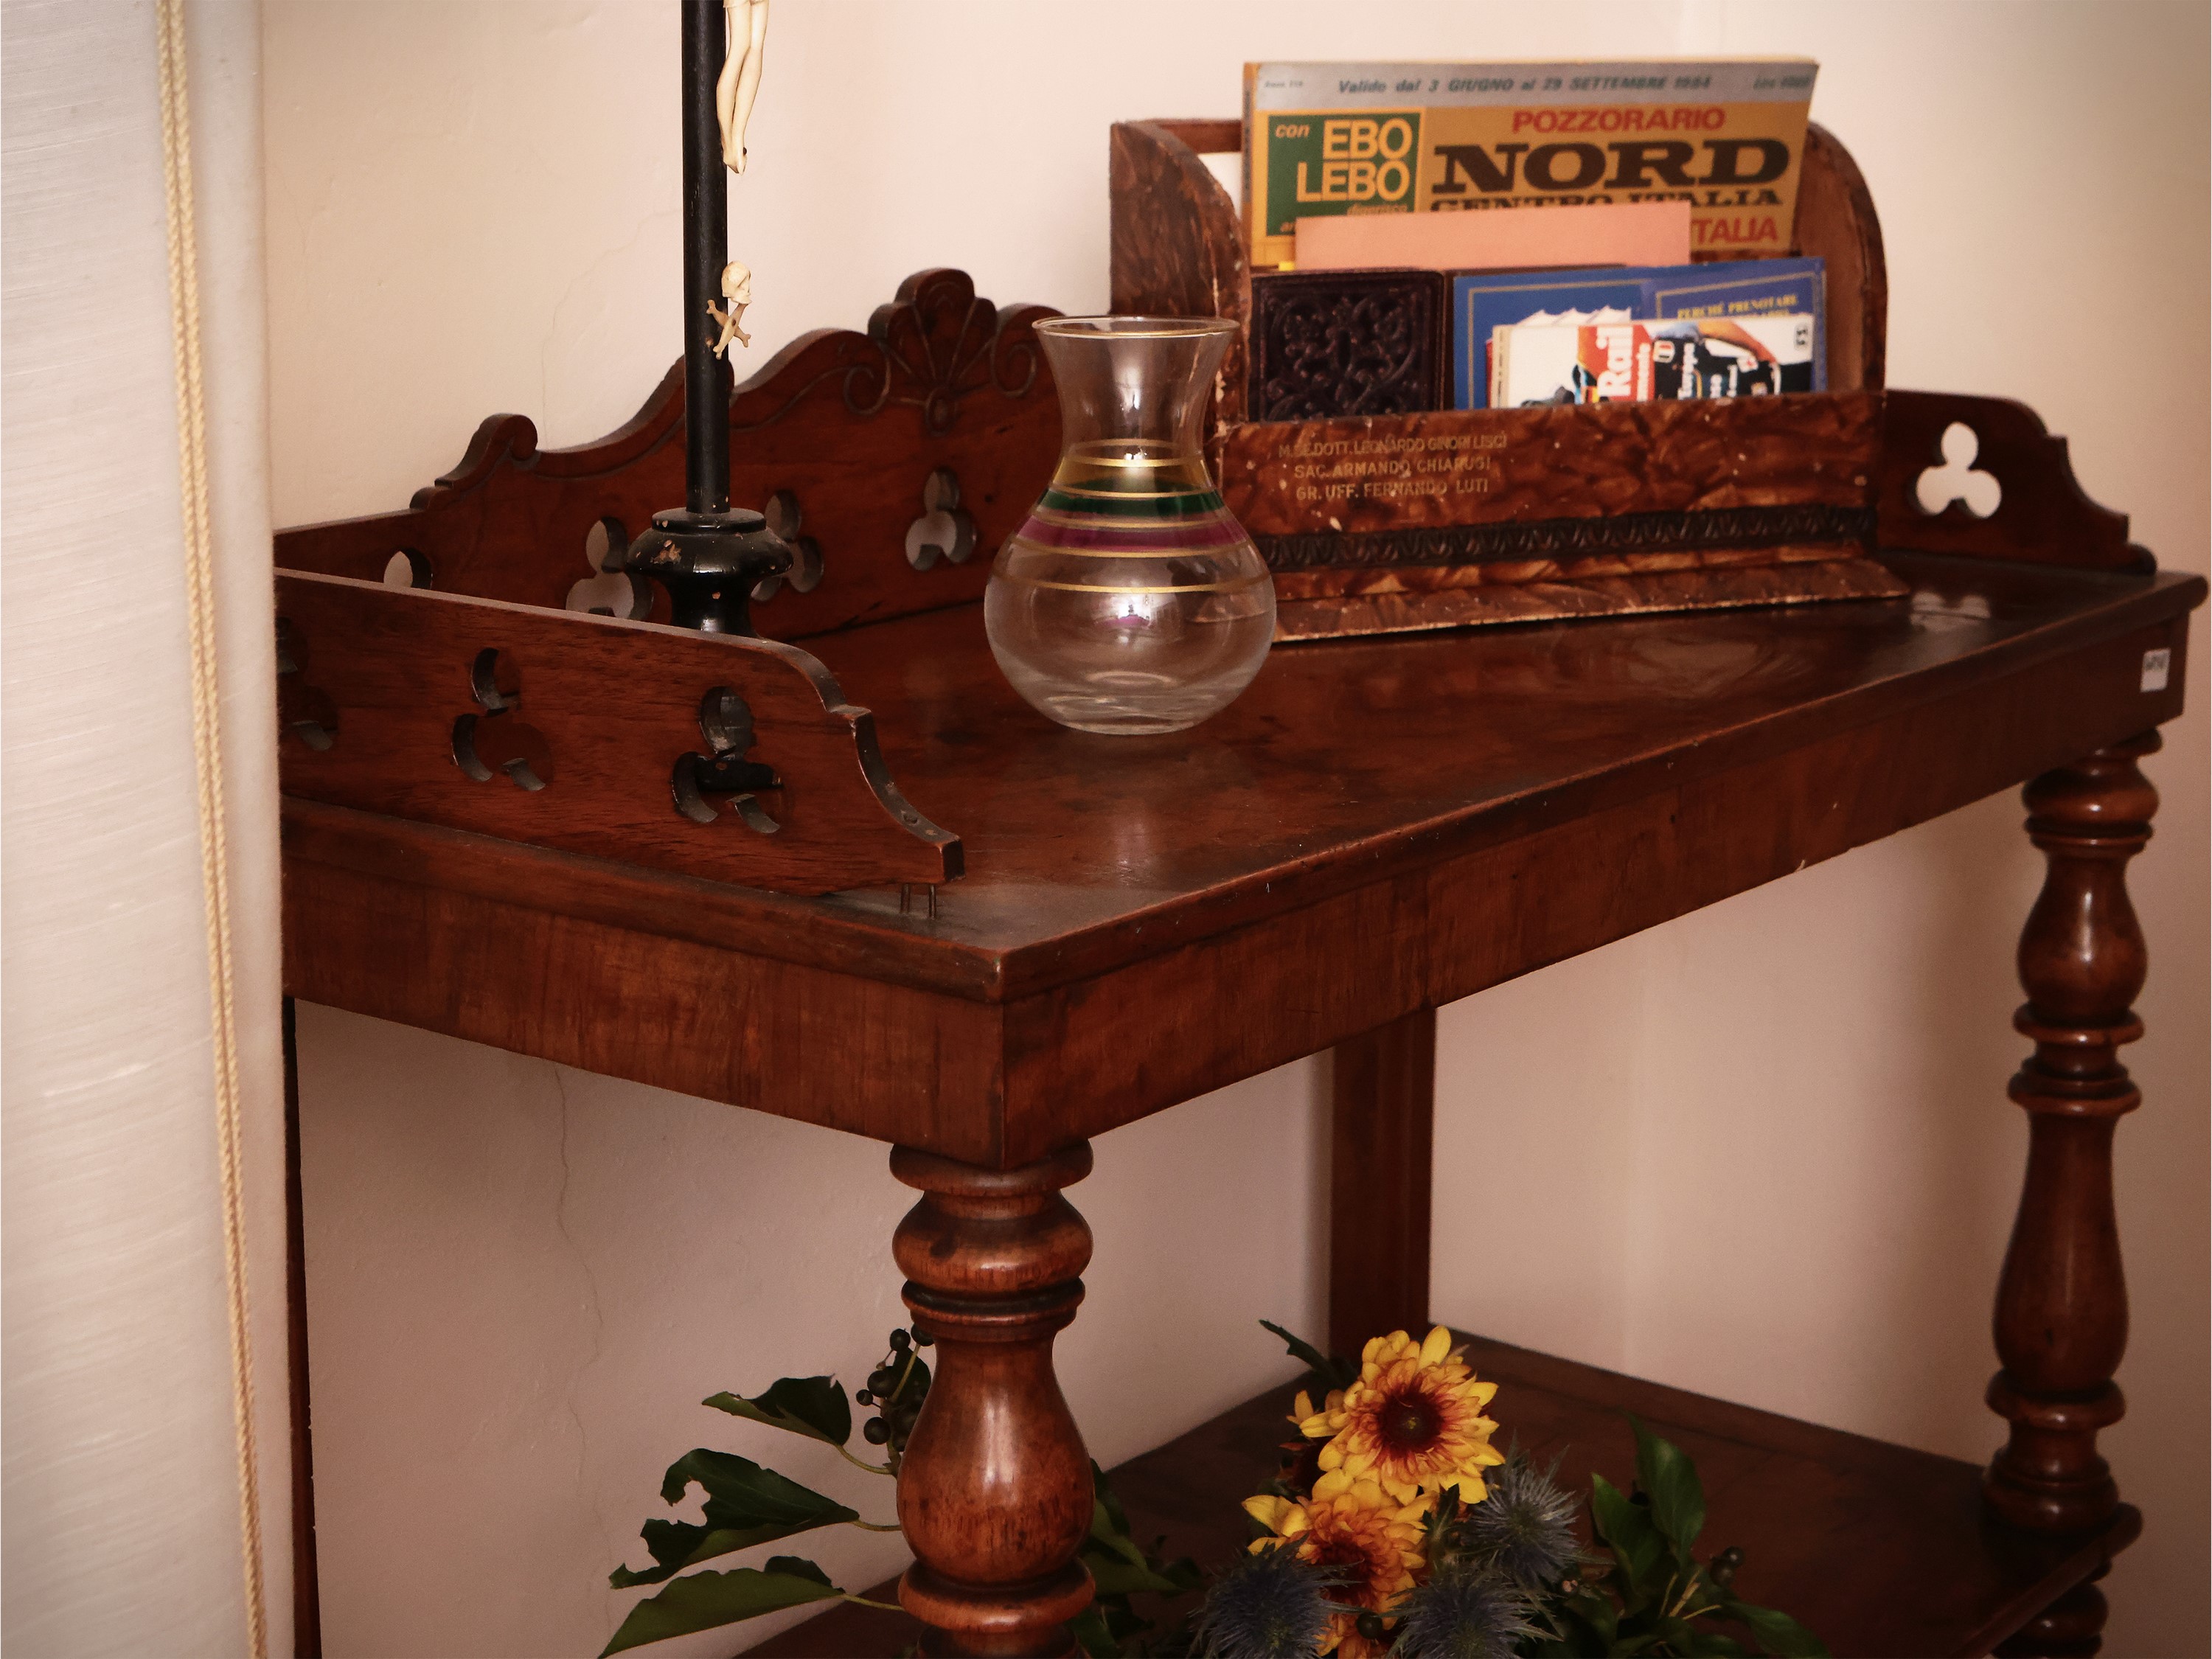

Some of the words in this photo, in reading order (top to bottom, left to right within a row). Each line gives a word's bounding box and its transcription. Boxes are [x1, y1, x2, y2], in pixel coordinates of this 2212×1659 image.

[1395, 79, 1421, 92] dal
[1428, 79, 1439, 92] 3
[1447, 77, 1514, 92] GIUGNO
[1569, 76, 1667, 91] SETTEMBRE
[1276, 124, 1310, 139] con
[1513, 108, 1726, 134] POZZORARIO
[1323, 118, 1413, 160] EBO
[1432, 138, 1790, 194] NORD
[1296, 159, 1411, 202] LEBO
[1691, 218, 1778, 245] TALIA
[1364, 480, 1447, 498] FERNANDO
[1456, 478, 1488, 494] LUTI
